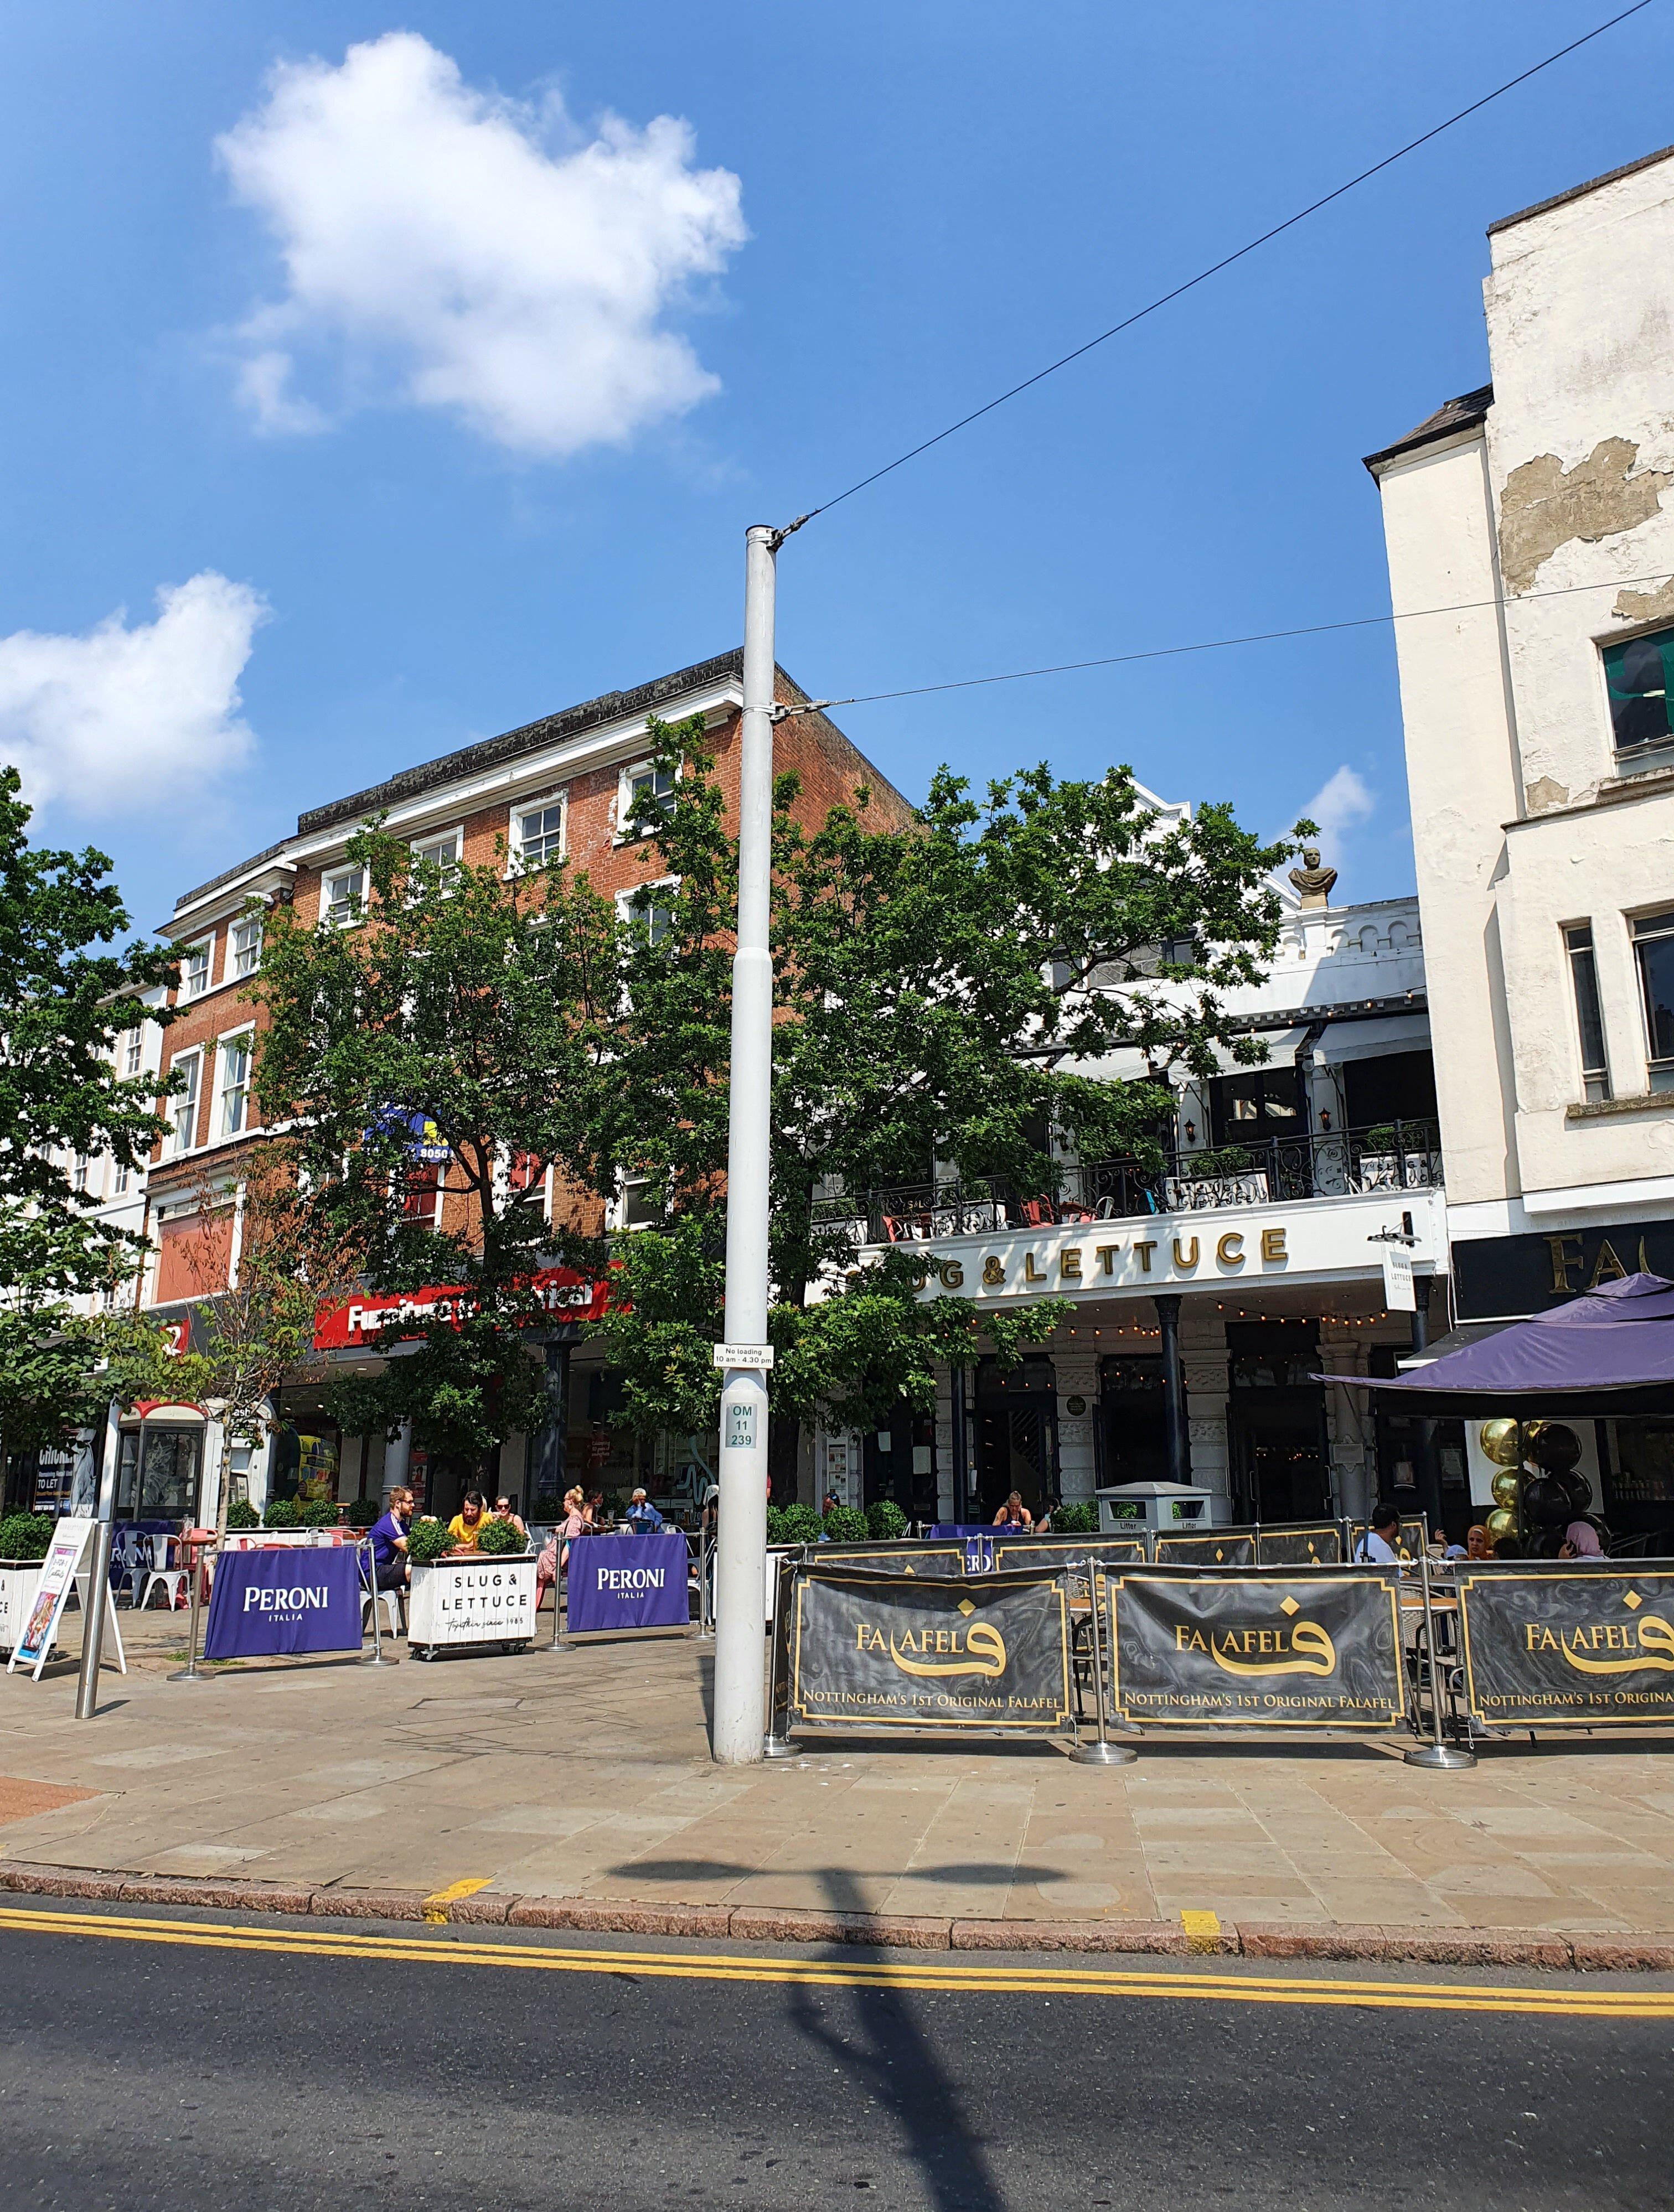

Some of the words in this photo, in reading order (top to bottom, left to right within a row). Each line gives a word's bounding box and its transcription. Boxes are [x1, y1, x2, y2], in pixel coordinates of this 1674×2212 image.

[983, 1255, 1006, 1285] &
[1025, 1228, 1288, 1282] LETTUCE
[1391, 1273, 1412, 1282] LETTUCE
[733, 1406, 752, 1416] OM
[736, 1420, 747, 1431] 11
[731, 1435, 752, 1445] 239
[38, 1479, 45, 1489] TO
[46, 1478, 58, 1489] LET
[1120, 1522, 1136, 1530] Litter
[454, 1574, 502, 1588] SLUG
[509, 1573, 517, 1586] &
[597, 1568, 665, 1590] PERONI
[243, 1587, 328, 1612] PERONI
[442, 1594, 527, 1610] LETTUCE
[268, 1613, 303, 1622] ITALIA
[481, 1619, 504, 1629] since
[803, 1689, 906, 1706] NOTTINGHAM'S
[912, 1695, 933, 1707] 1ST
[937, 1695, 1004, 1708] ORIGINAL
[1125, 1692, 1232, 1706] NOTTINGHAM'S
[1237, 1695, 1259, 1707] 1ST
[1264, 1695, 1335, 1708] ORIGINAL
[1479, 1691, 1583, 1707] NOTTINGHAM'S
[1589, 1692, 1611, 1705] 1ST
[1614, 1691, 1674, 1705] ORIGINA
